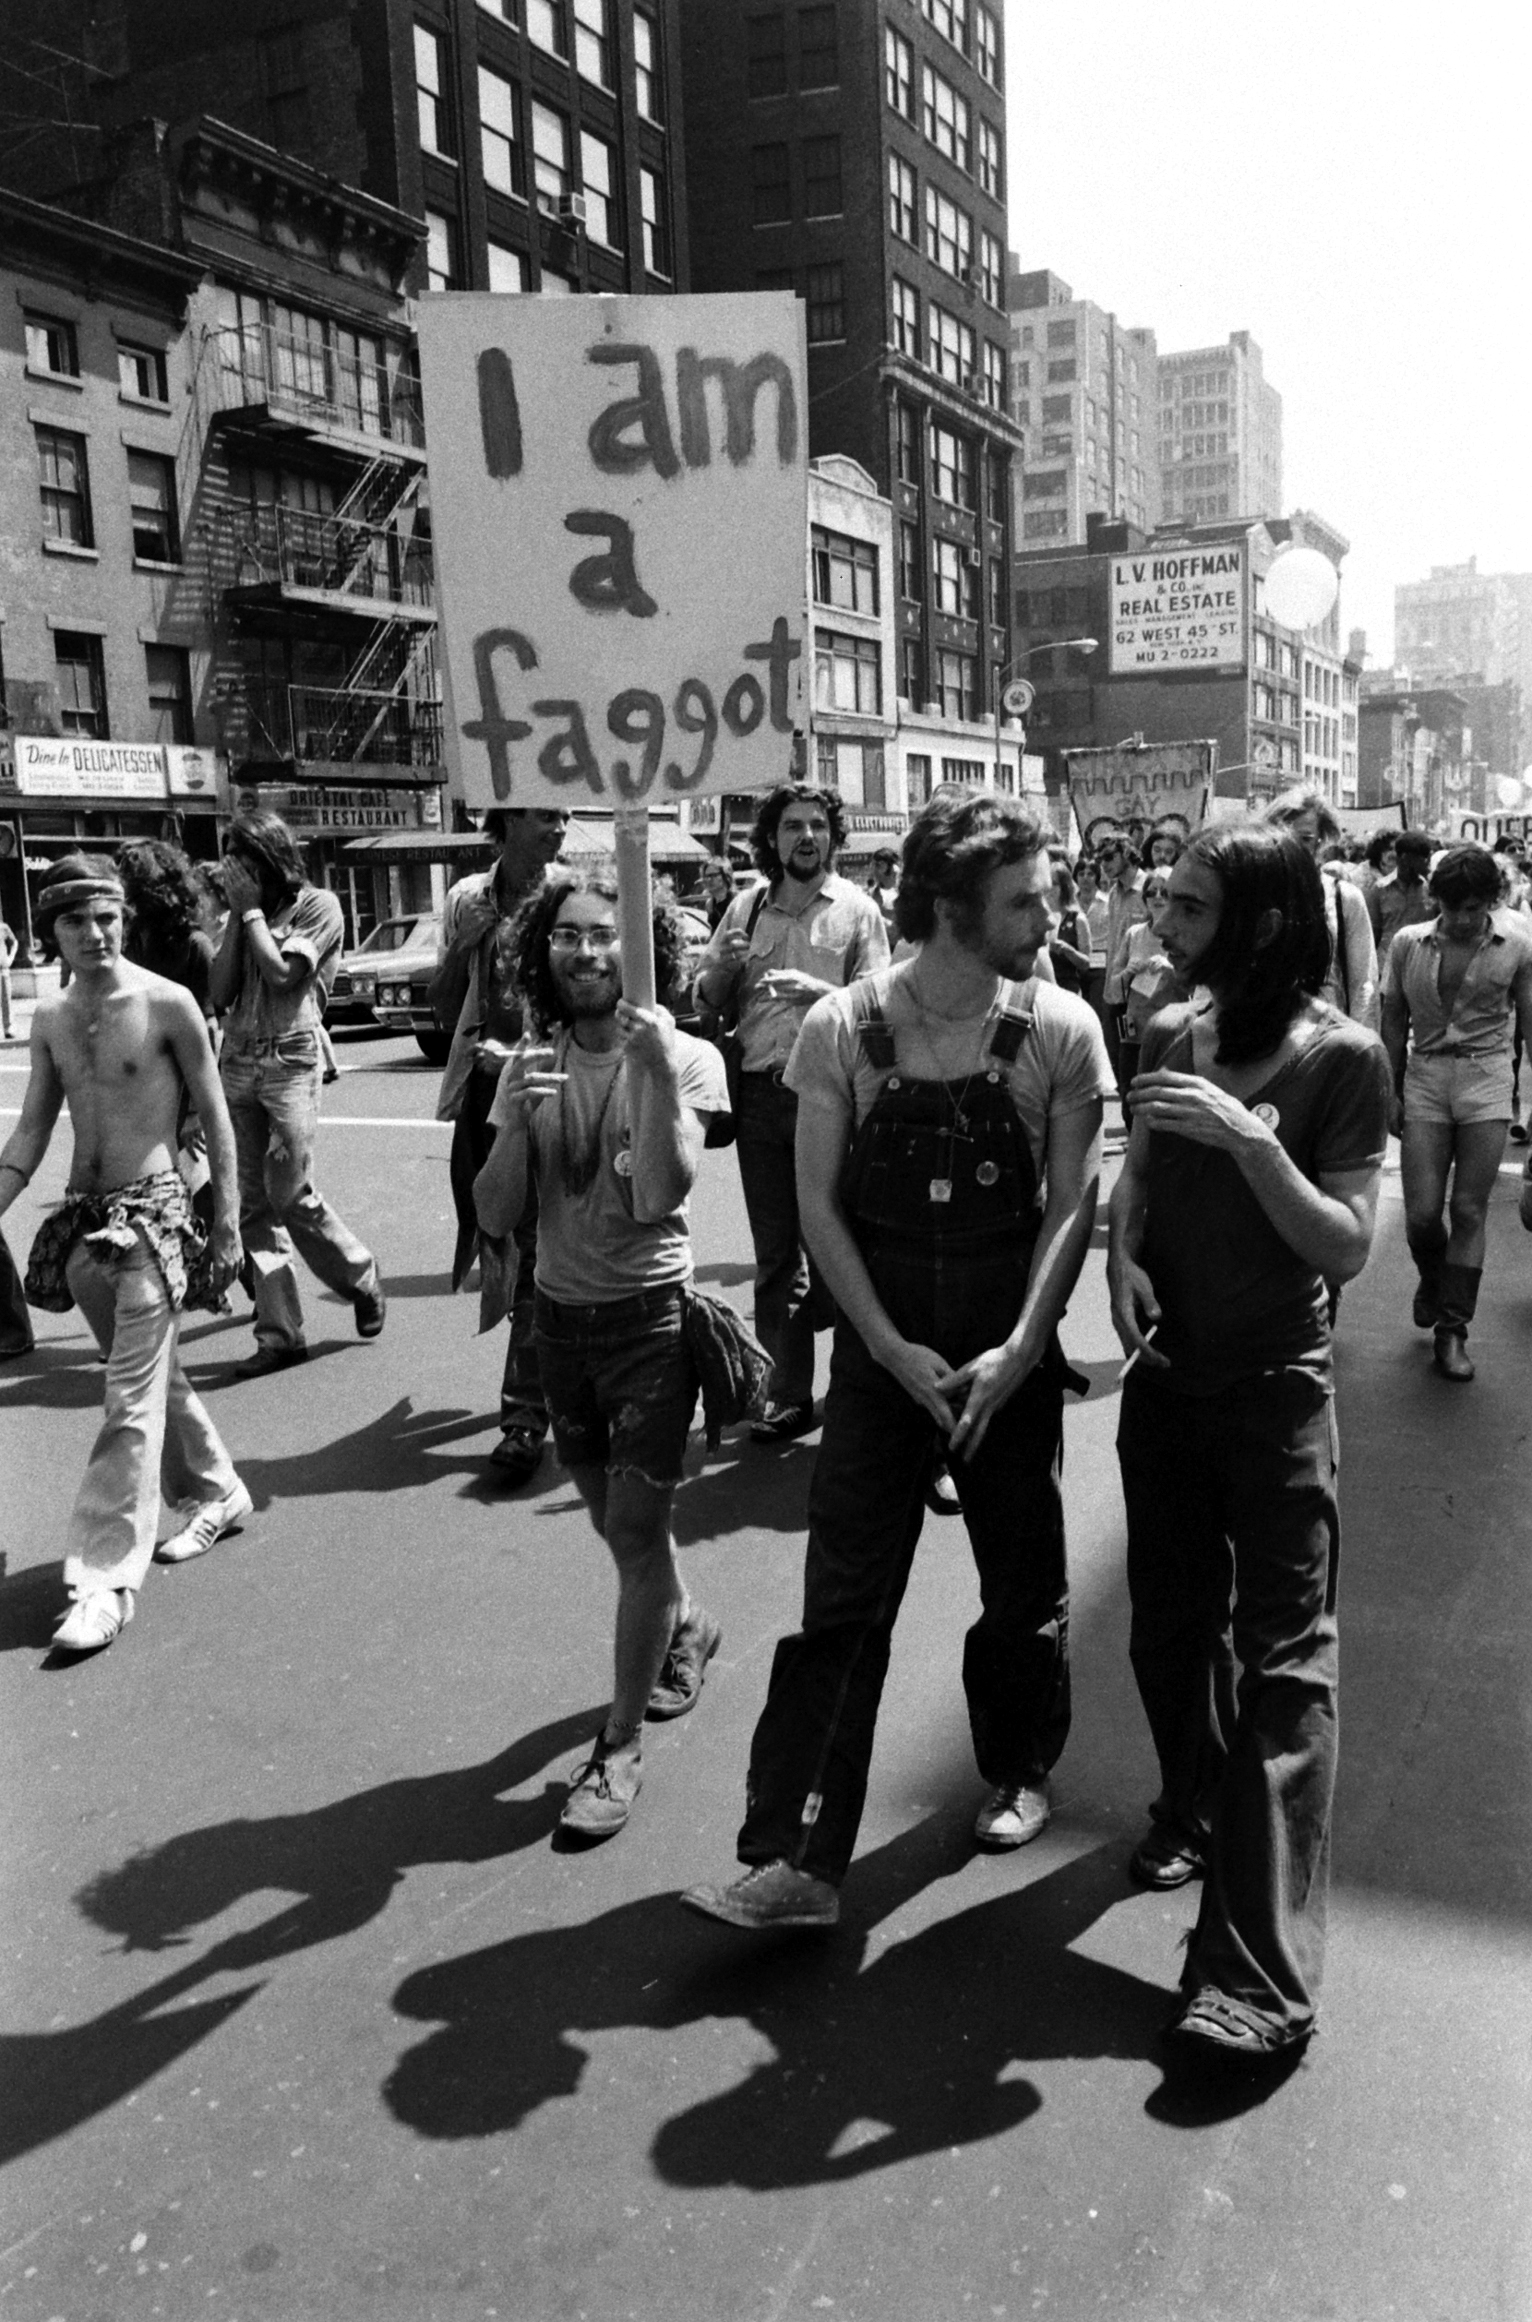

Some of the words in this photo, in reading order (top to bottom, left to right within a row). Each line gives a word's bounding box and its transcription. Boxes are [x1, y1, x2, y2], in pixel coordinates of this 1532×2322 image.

[477, 346, 523, 480] I
[585, 343, 798, 481] am
[563, 508, 659, 618] a
[1153, 553, 1240, 581] HOFFMAN
[1157, 584, 1166, 595] &
[1120, 599, 1162, 616] REAL
[1169, 590, 1236, 612] ESTATE
[1116, 631, 1135, 644] 62
[1142, 626, 1181, 642] WEST
[1136, 651, 1155, 662] MU
[461, 616, 802, 800] faggot
[26, 744, 56, 765] Dine
[73, 746, 163, 773] DELICATESSEN
[289, 790, 355, 806] ORIENTAL
[1115, 793, 1160, 815] GAY
[322, 809, 408, 827] RESTAURANT
